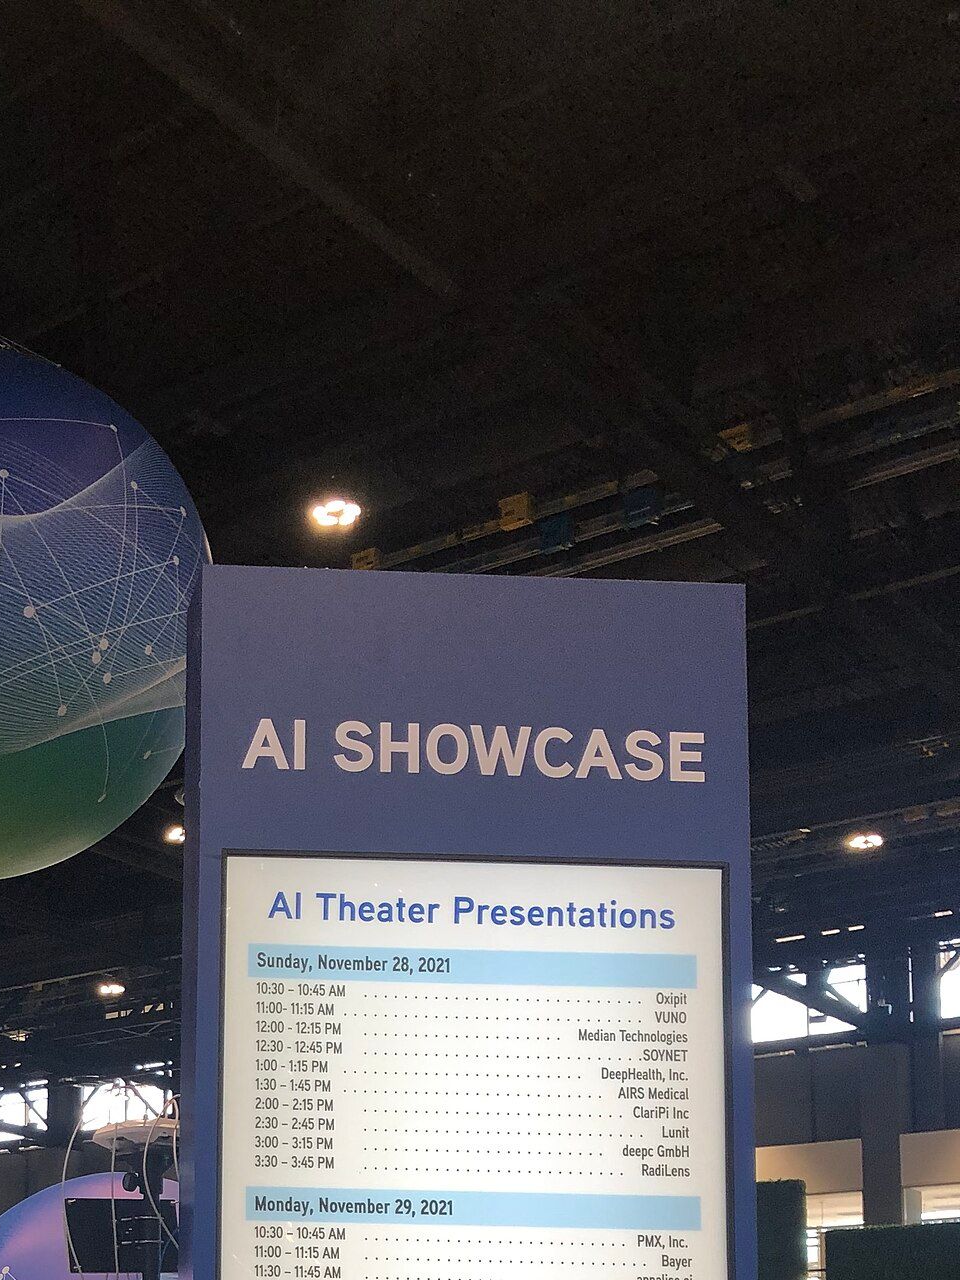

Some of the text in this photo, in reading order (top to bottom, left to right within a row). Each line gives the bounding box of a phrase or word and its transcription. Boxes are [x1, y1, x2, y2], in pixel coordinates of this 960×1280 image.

[242, 718, 706, 783] AI SHOWCASE
[268, 891, 675, 930] AI Theater Presentations
[257, 952, 450, 976] Sunday, November 28, 2021
[656, 992, 687, 1008] Oxipit
[654, 1011, 686, 1024] VUNO
[578, 1028, 688, 1046] Median Technologies
[643, 1049, 688, 1062] SOYNET
[602, 1067, 688, 1084] DeepHealth, Inc.
[618, 1086, 689, 1100] AIRS Medical
[633, 1106, 689, 1119] ClariPi Inc
[662, 1125, 689, 1139] Lunit
[622, 1144, 689, 1160] deepc GmbH
[642, 1164, 690, 1177] RadiLens
[255, 1196, 452, 1218] Monday, November 29, 2021
[638, 1234, 688, 1250] PMX, Inc.
[662, 1254, 692, 1271] Bayer
